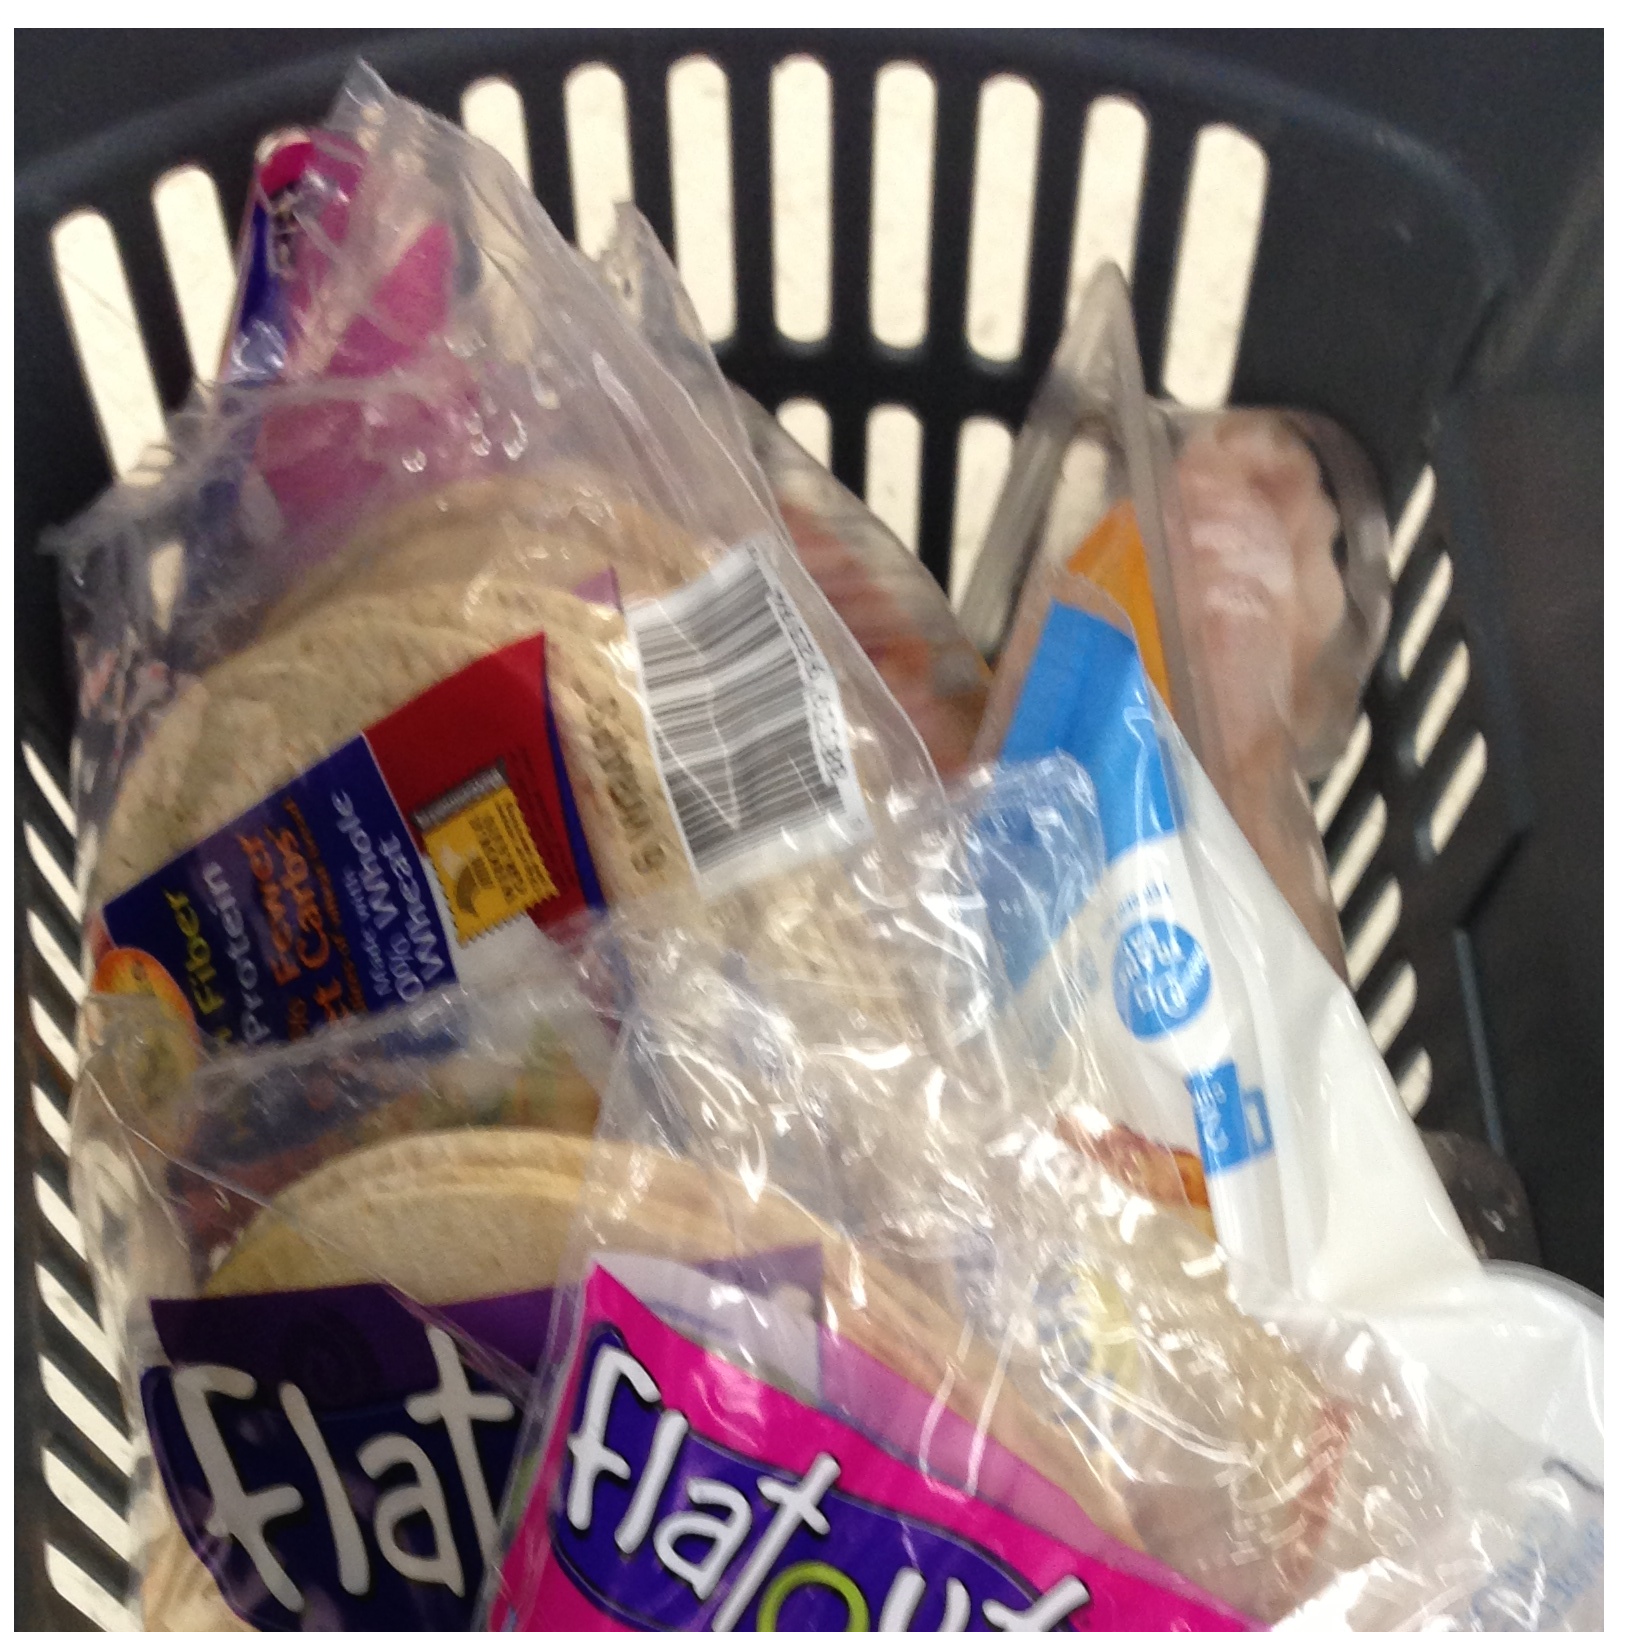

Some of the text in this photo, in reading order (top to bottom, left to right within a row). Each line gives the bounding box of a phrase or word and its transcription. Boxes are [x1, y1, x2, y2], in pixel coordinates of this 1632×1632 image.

[331, 790, 392, 930] Whole
[378, 832, 445, 979] Wheat
[171, 1325, 515, 1613] Flat
